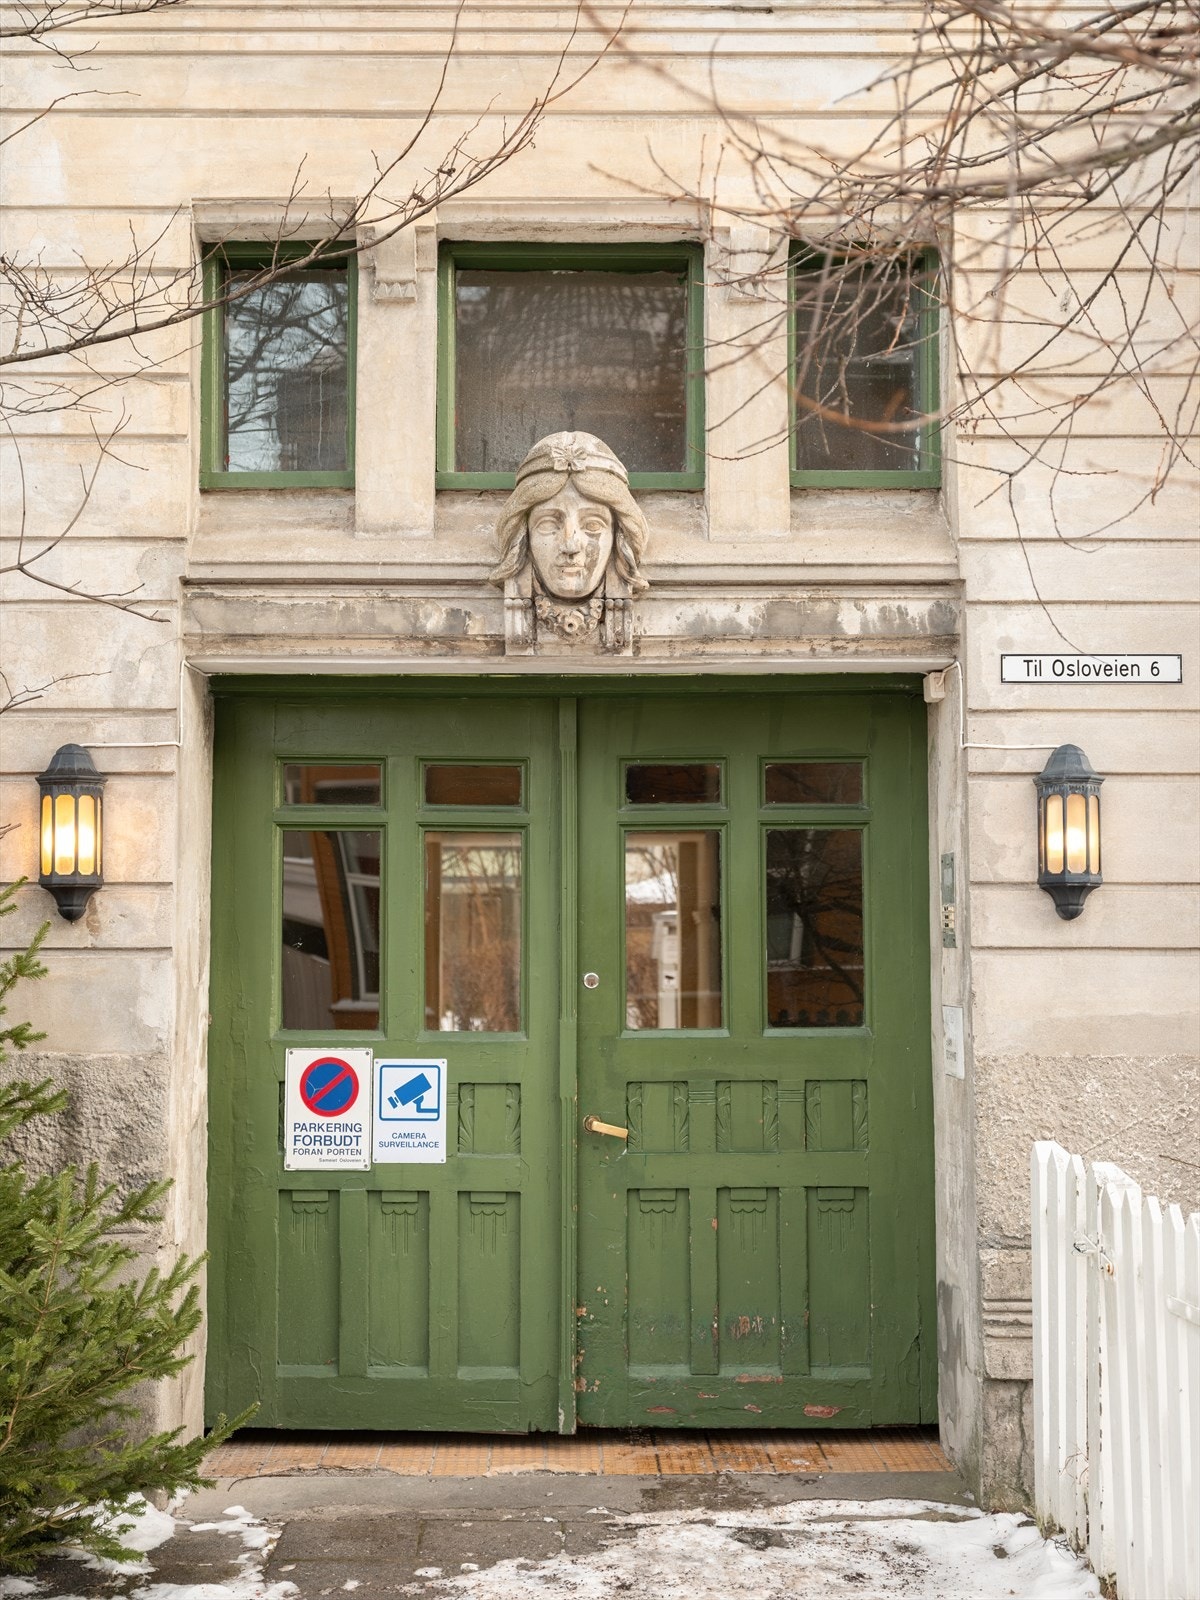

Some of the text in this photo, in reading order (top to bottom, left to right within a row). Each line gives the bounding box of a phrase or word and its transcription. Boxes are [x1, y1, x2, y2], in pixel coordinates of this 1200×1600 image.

[1023, 659, 1160, 677] Til Osloveien 6
[293, 1122, 362, 1132] PARKERING
[293, 1134, 362, 1146] FORBUDT
